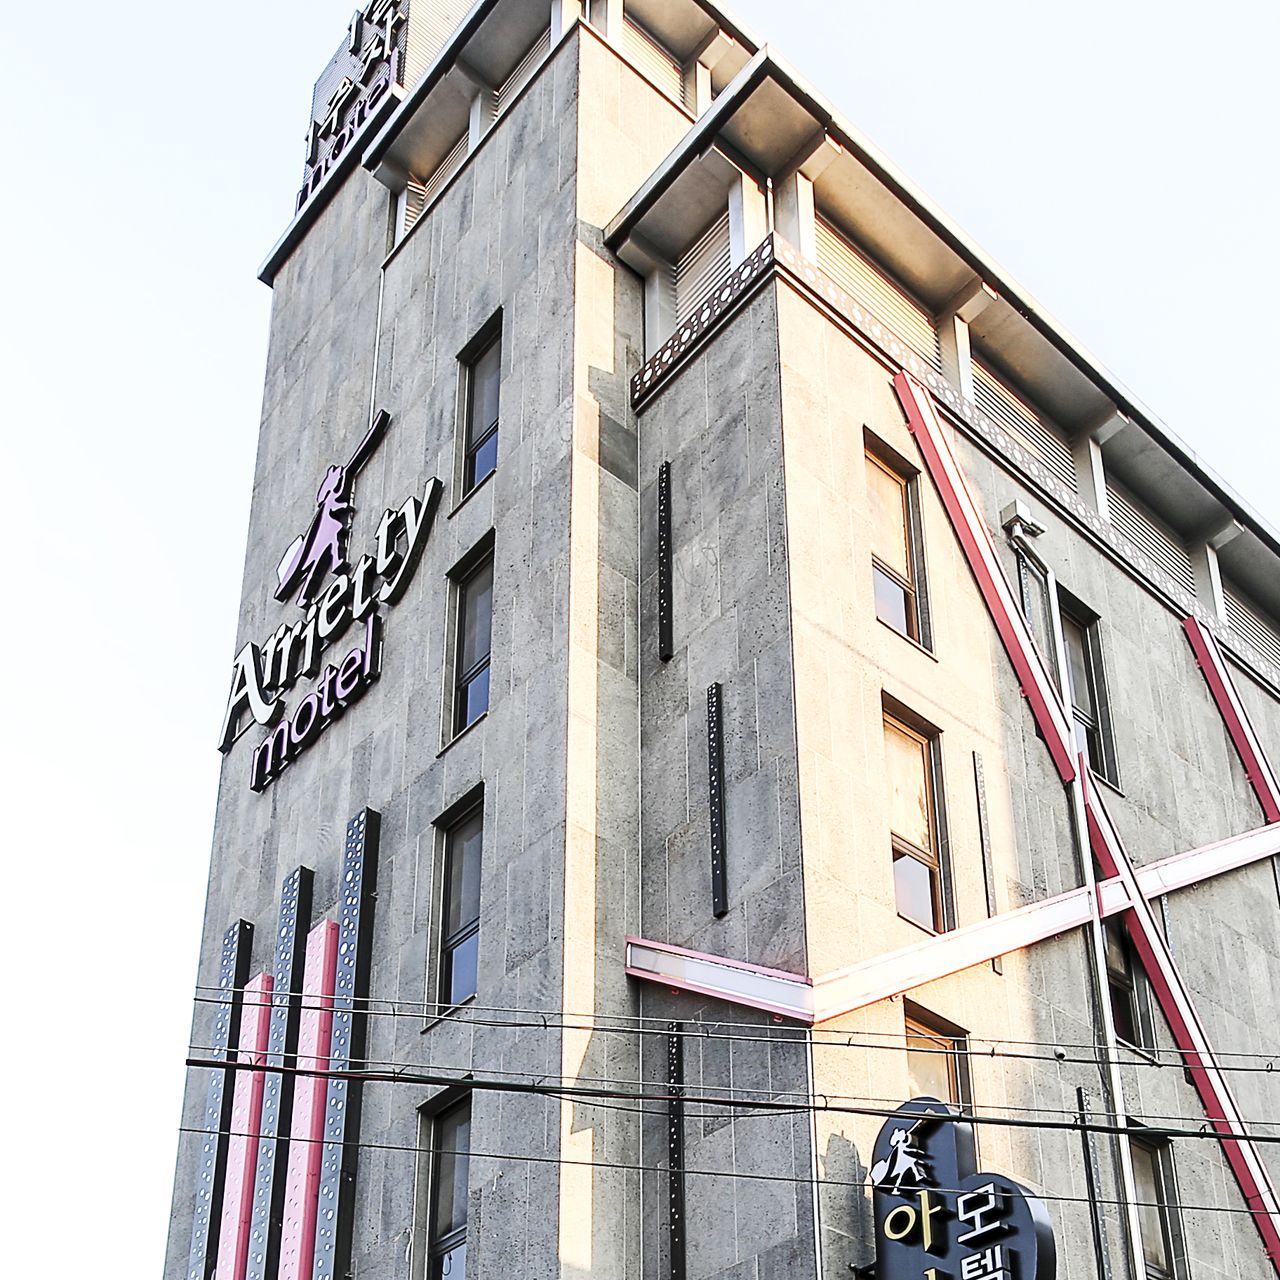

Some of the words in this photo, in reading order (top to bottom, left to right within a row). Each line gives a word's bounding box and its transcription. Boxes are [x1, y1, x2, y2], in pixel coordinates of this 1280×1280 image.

[295, 47, 399, 215] motel
[218, 478, 440, 752] Arrietty
[251, 613, 378, 791] motel
